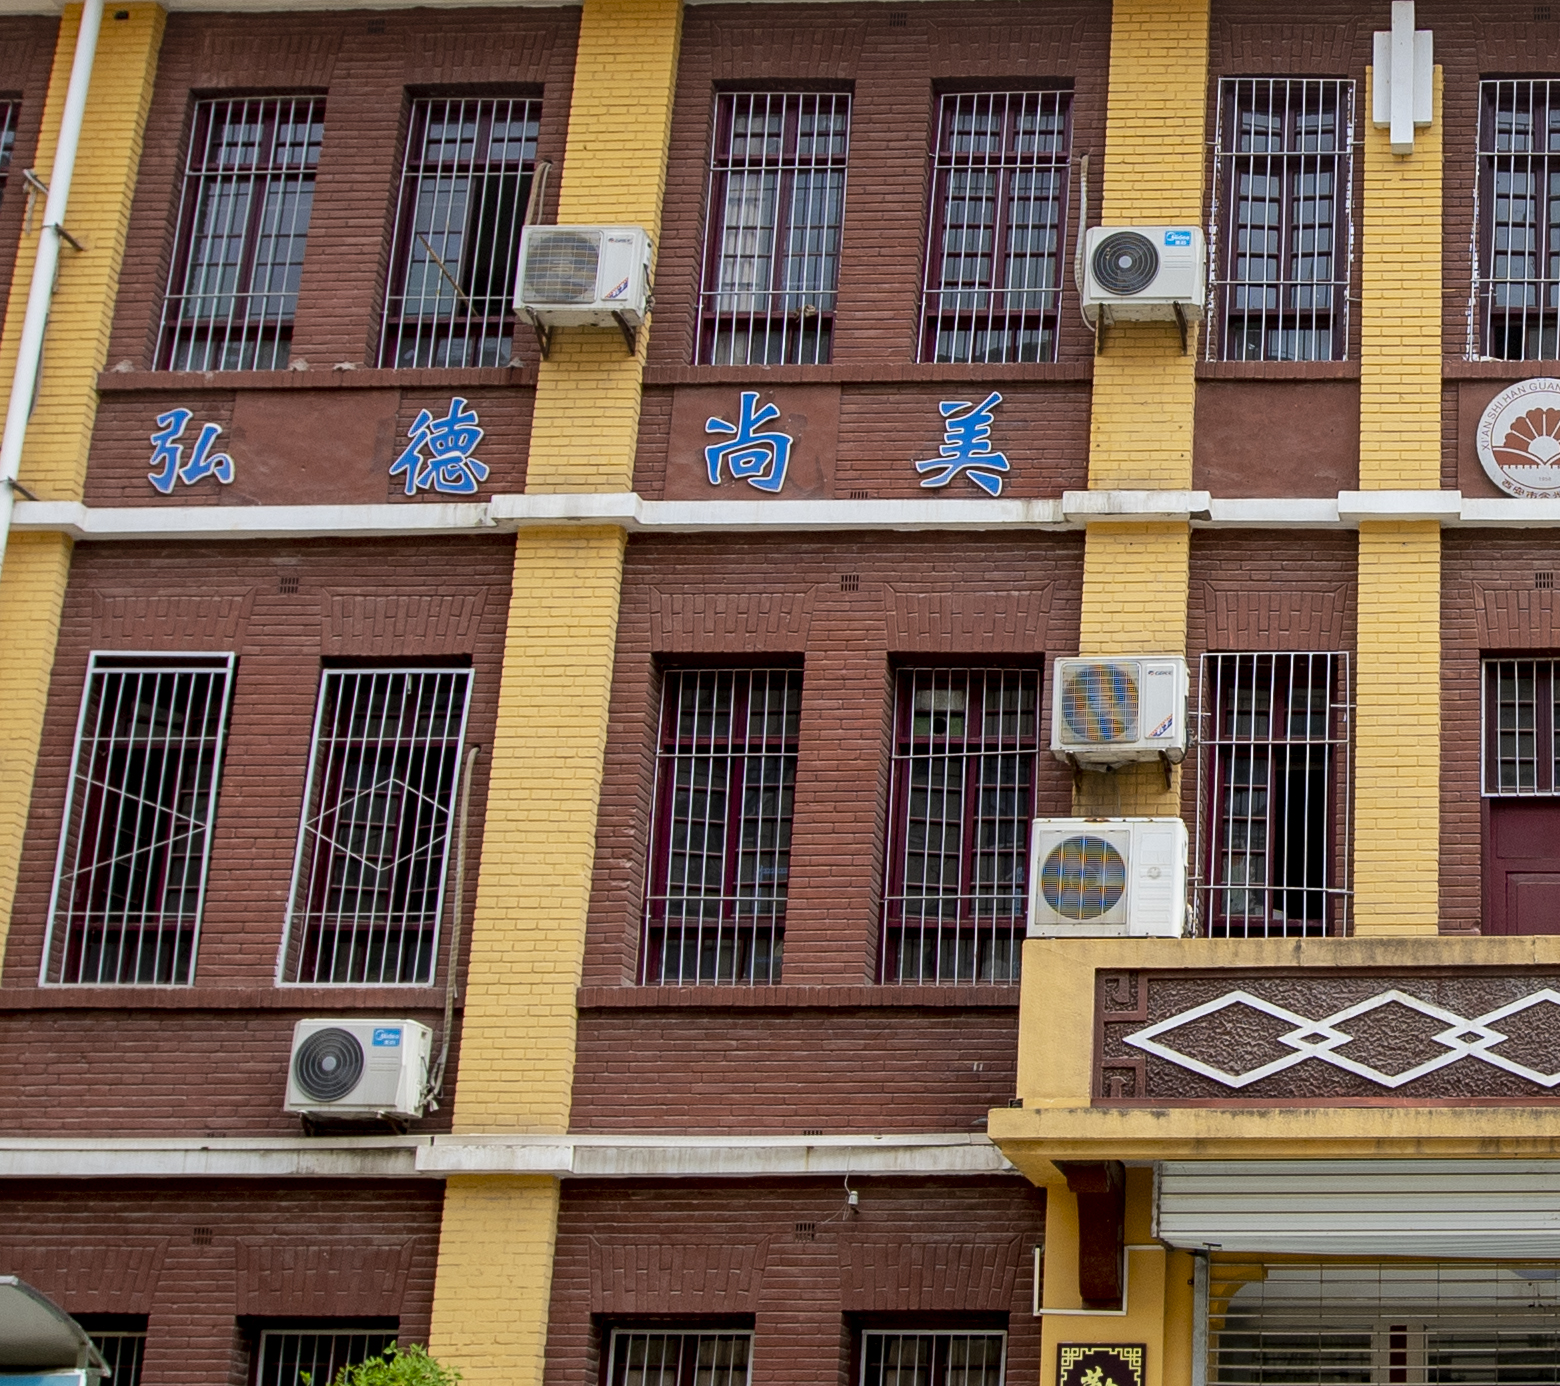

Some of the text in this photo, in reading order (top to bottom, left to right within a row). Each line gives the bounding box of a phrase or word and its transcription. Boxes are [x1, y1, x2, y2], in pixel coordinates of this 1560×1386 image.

[1487, 401, 1504, 420] SHI
[1502, 385, 1527, 403] HAN
[148, 390, 1011, 497] 弘德尚美
